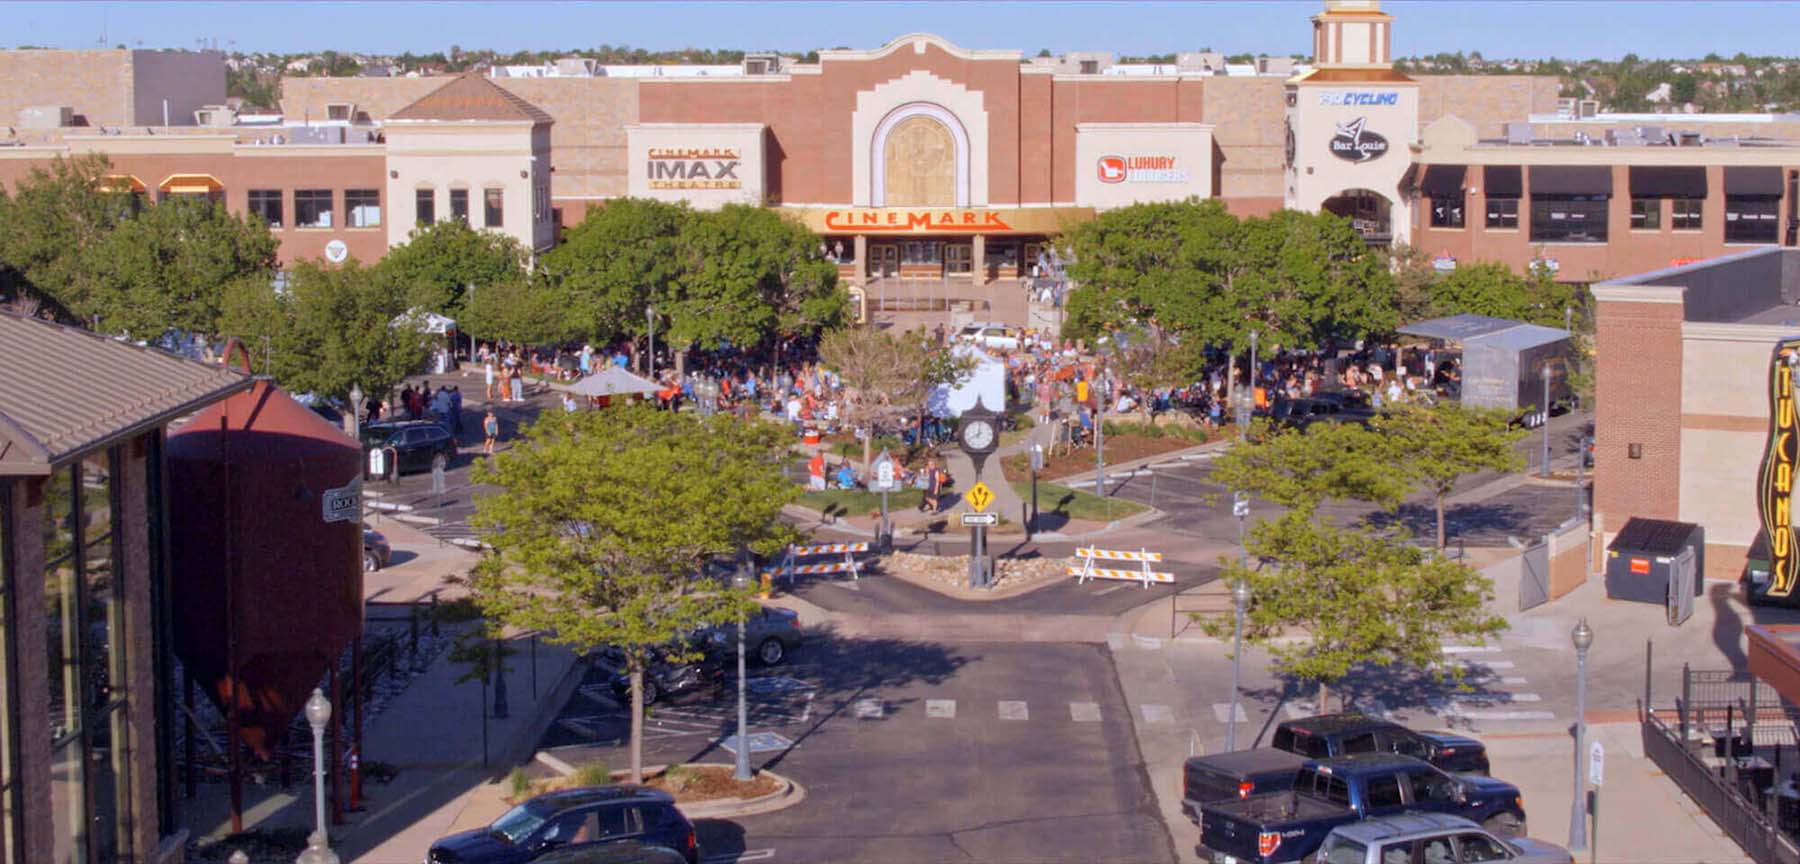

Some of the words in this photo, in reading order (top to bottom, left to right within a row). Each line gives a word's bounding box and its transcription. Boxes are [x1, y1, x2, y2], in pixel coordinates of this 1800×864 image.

[1343, 92, 1399, 106] CYCLING
[1333, 141, 1352, 151] Bar
[1354, 140, 1386, 151] Louie
[648, 147, 738, 159] CINEMARK
[647, 161, 738, 179] IMAX
[1128, 156, 1176, 170] LUXURY
[651, 181, 740, 190] THEATRE
[826, 211, 1014, 231] CINEMARK
